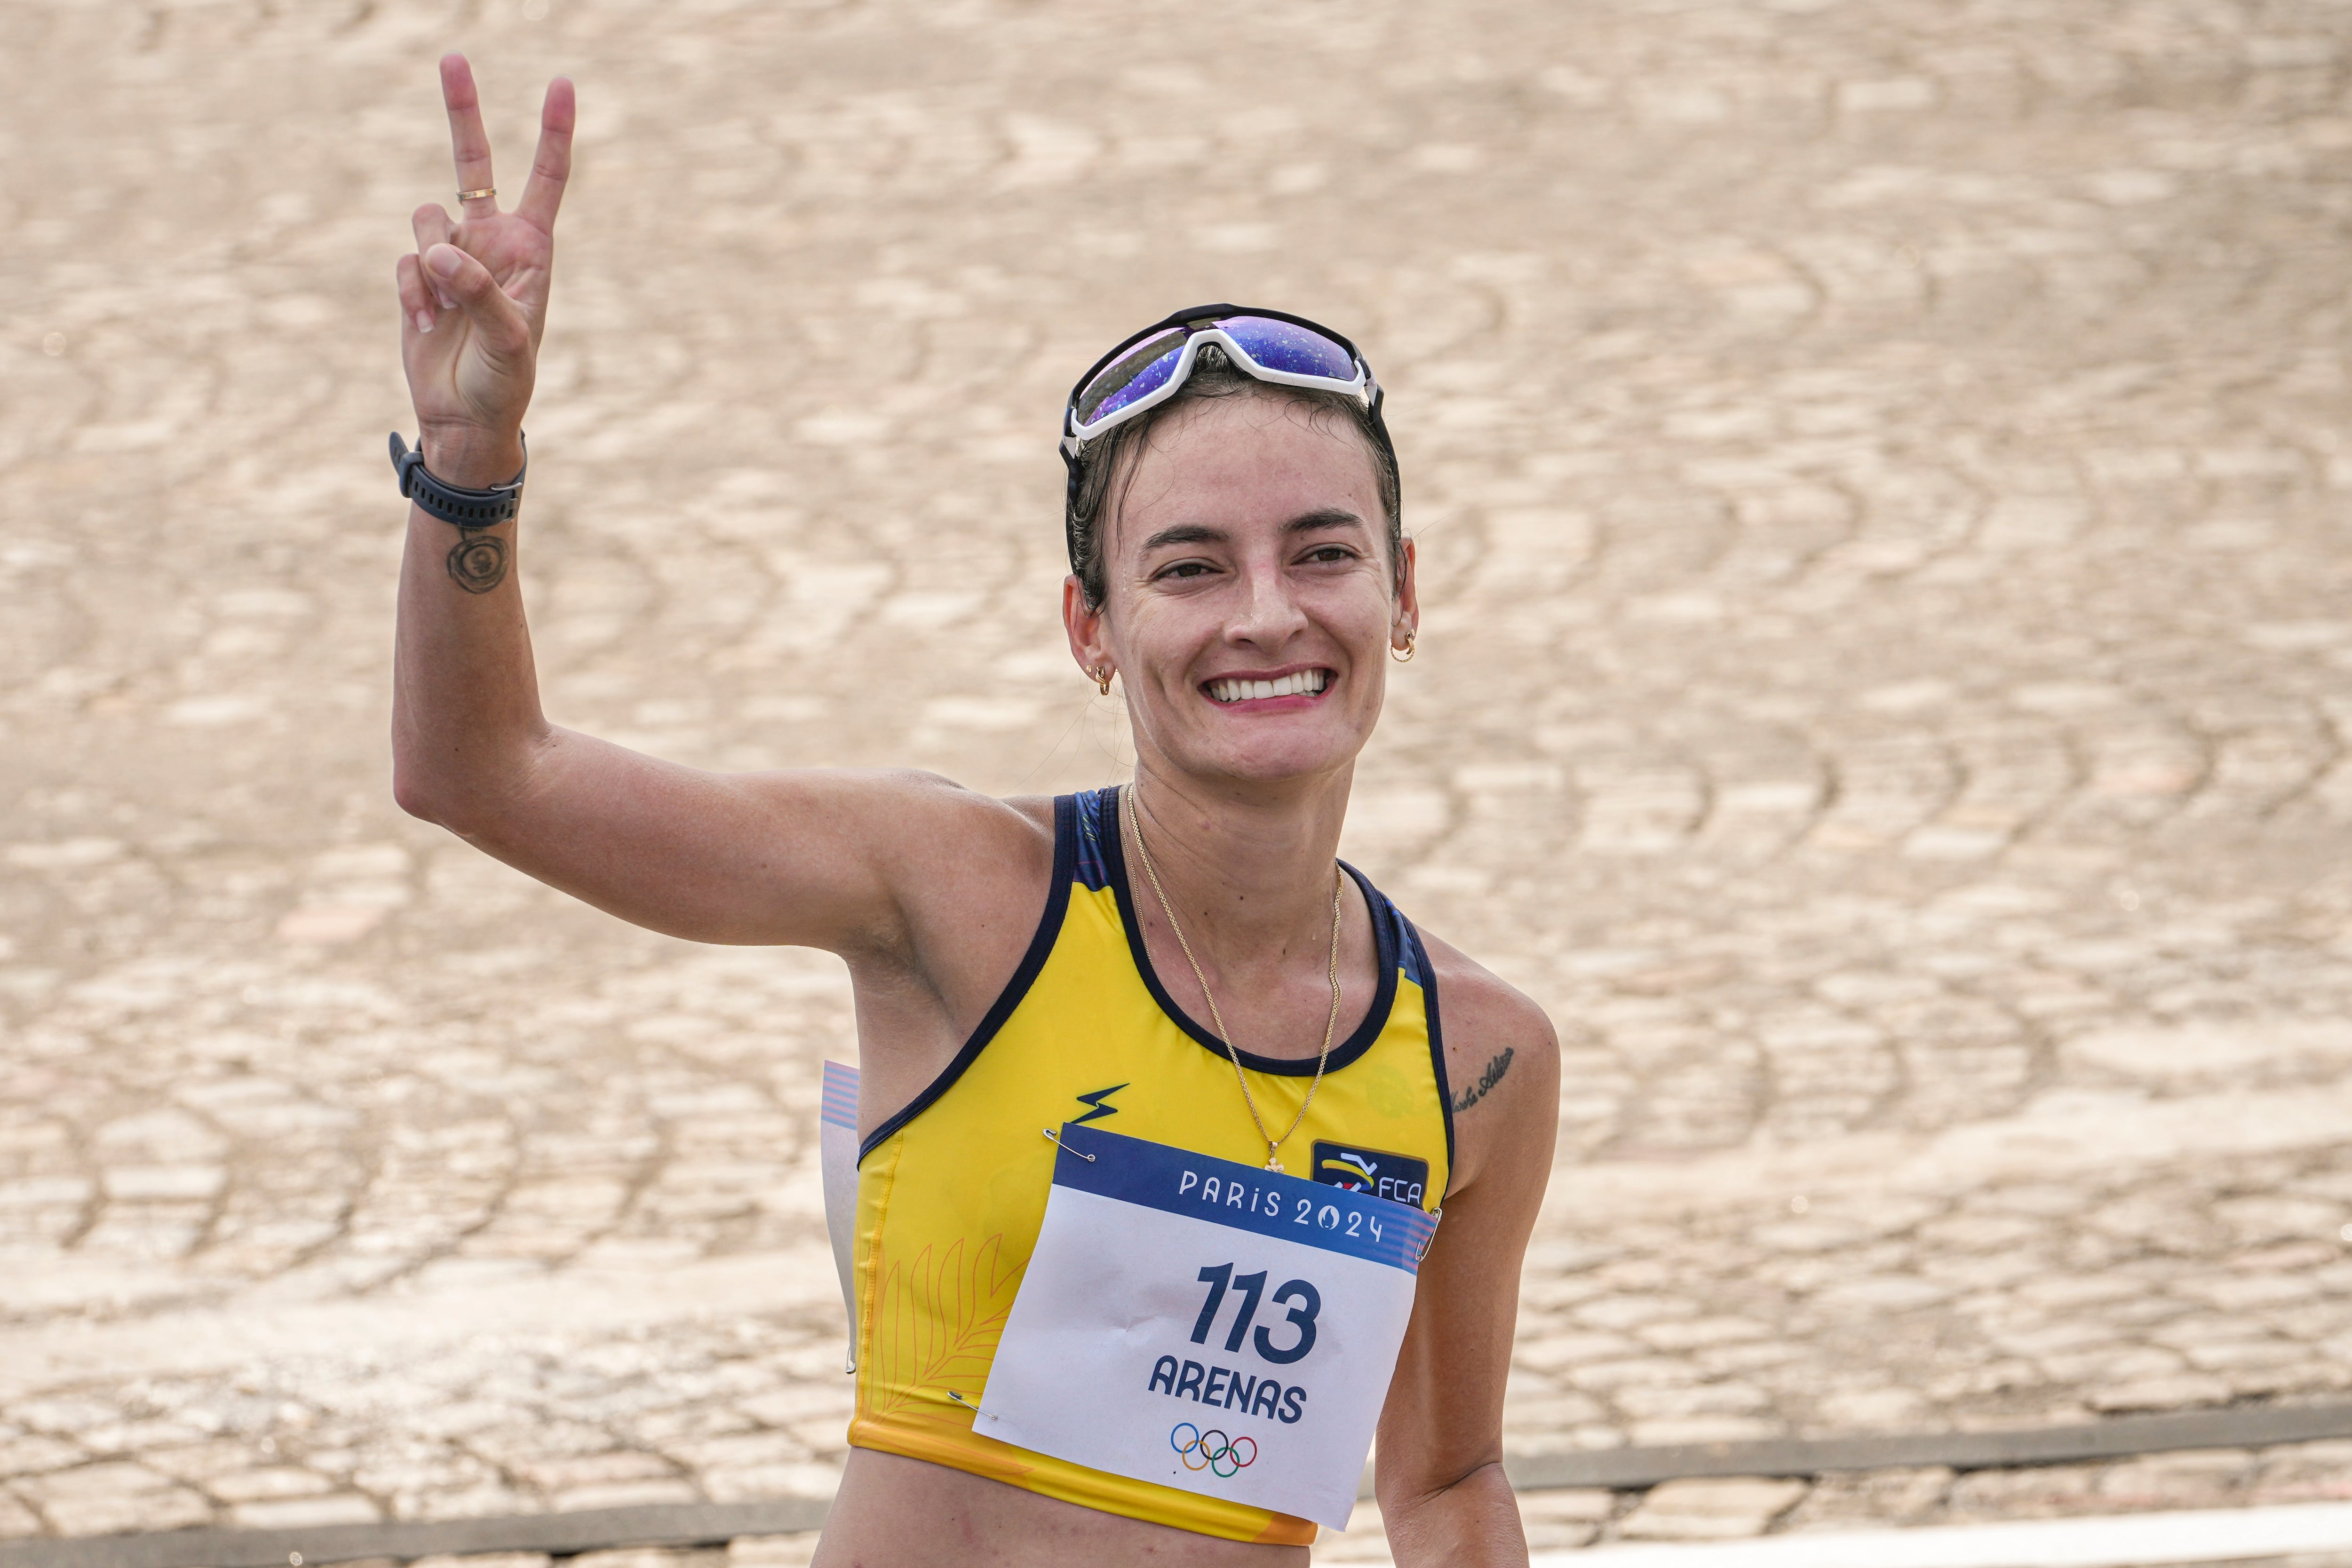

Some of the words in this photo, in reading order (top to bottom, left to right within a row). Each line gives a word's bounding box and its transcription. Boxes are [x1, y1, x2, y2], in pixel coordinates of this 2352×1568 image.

[1379, 1176, 1422, 1204] FCA
[1294, 1198, 1383, 1243] 2024
[1190, 1262, 1321, 1365] 113
[1148, 1355, 1307, 1424] ARENAS
